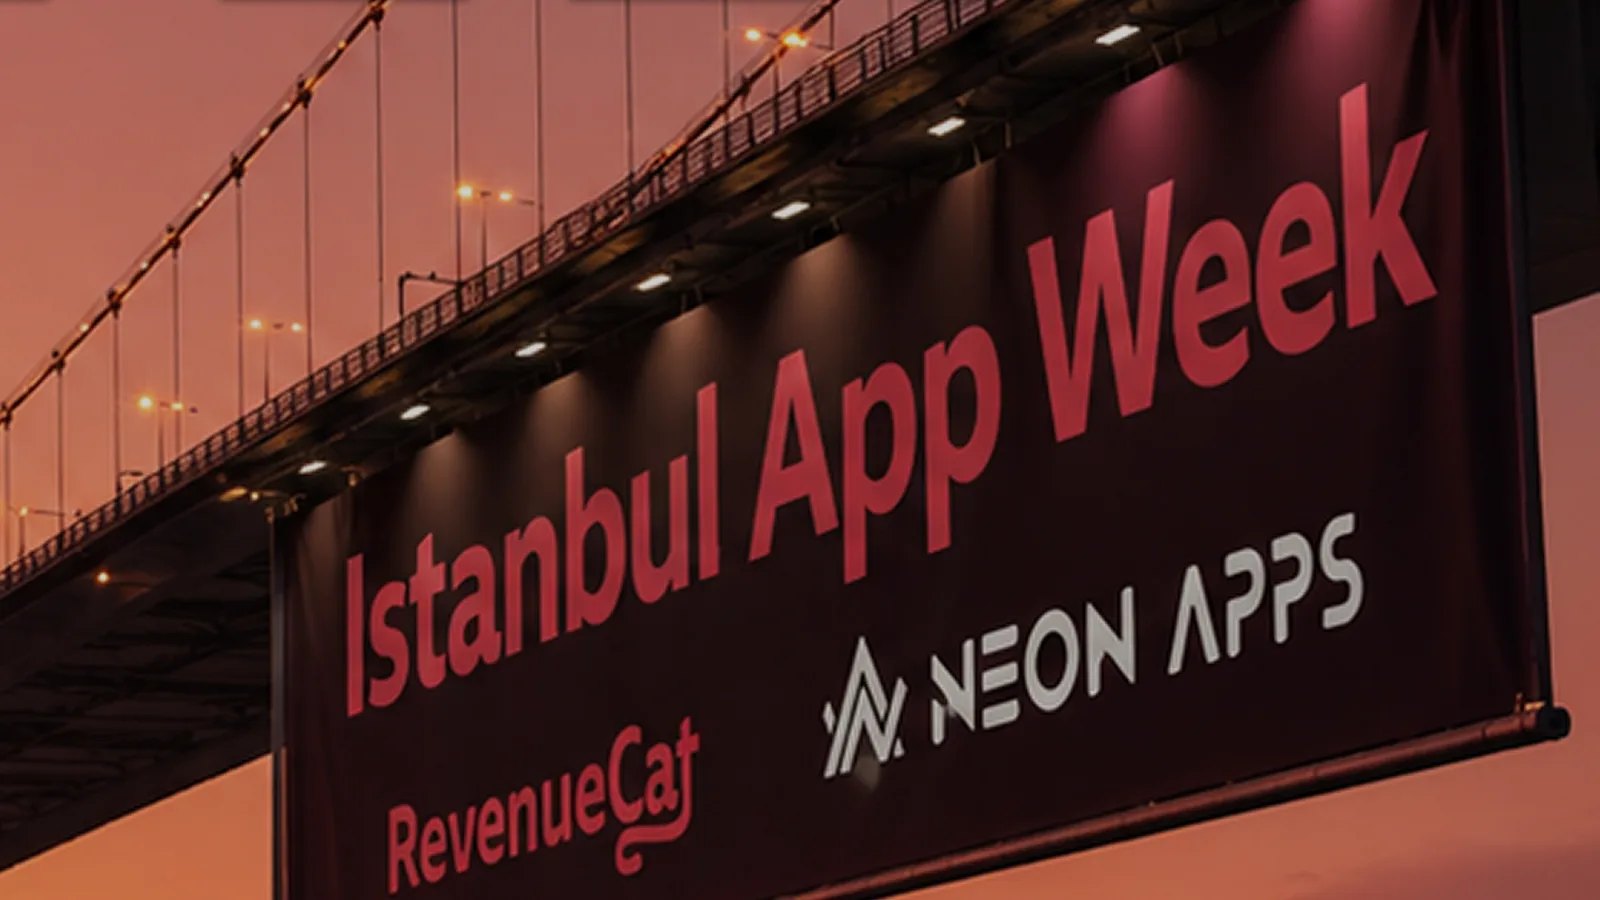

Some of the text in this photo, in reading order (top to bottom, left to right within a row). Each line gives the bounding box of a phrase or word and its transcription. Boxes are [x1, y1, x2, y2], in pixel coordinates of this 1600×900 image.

[346, 82, 1438, 717] Istanbul App Week
[931, 512, 1364, 746] NEON APPS
[387, 716, 701, 894] RevenueCat
